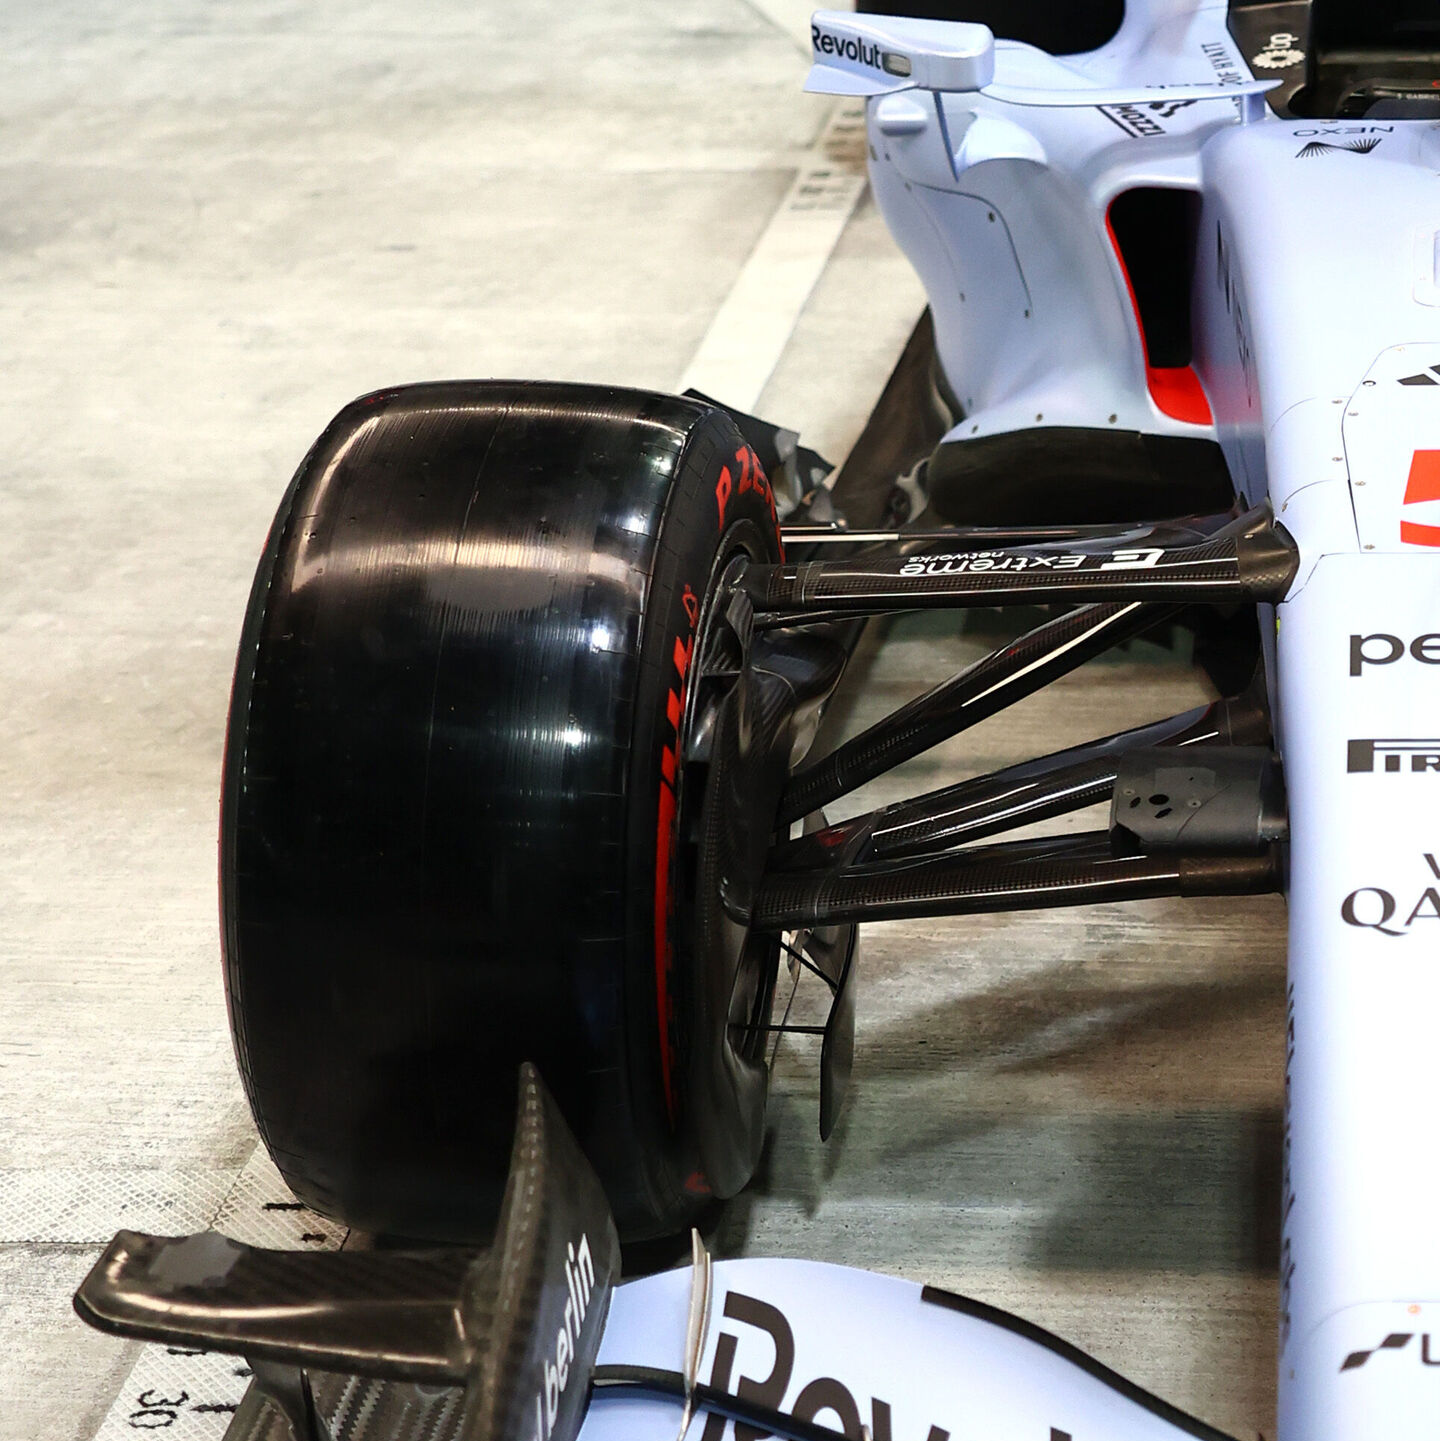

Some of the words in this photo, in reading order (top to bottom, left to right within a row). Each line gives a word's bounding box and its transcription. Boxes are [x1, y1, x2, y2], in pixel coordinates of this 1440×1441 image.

[811, 24, 883, 71] Revolut
[1263, 32, 1299, 51] bp
[1111, 105, 1166, 137] MOZZI
[1293, 125, 1395, 137] NEXO
[900, 554, 1087, 576] Extreme
[908, 550, 1004, 562] networks
[544, 1232, 596, 1438] berlin
